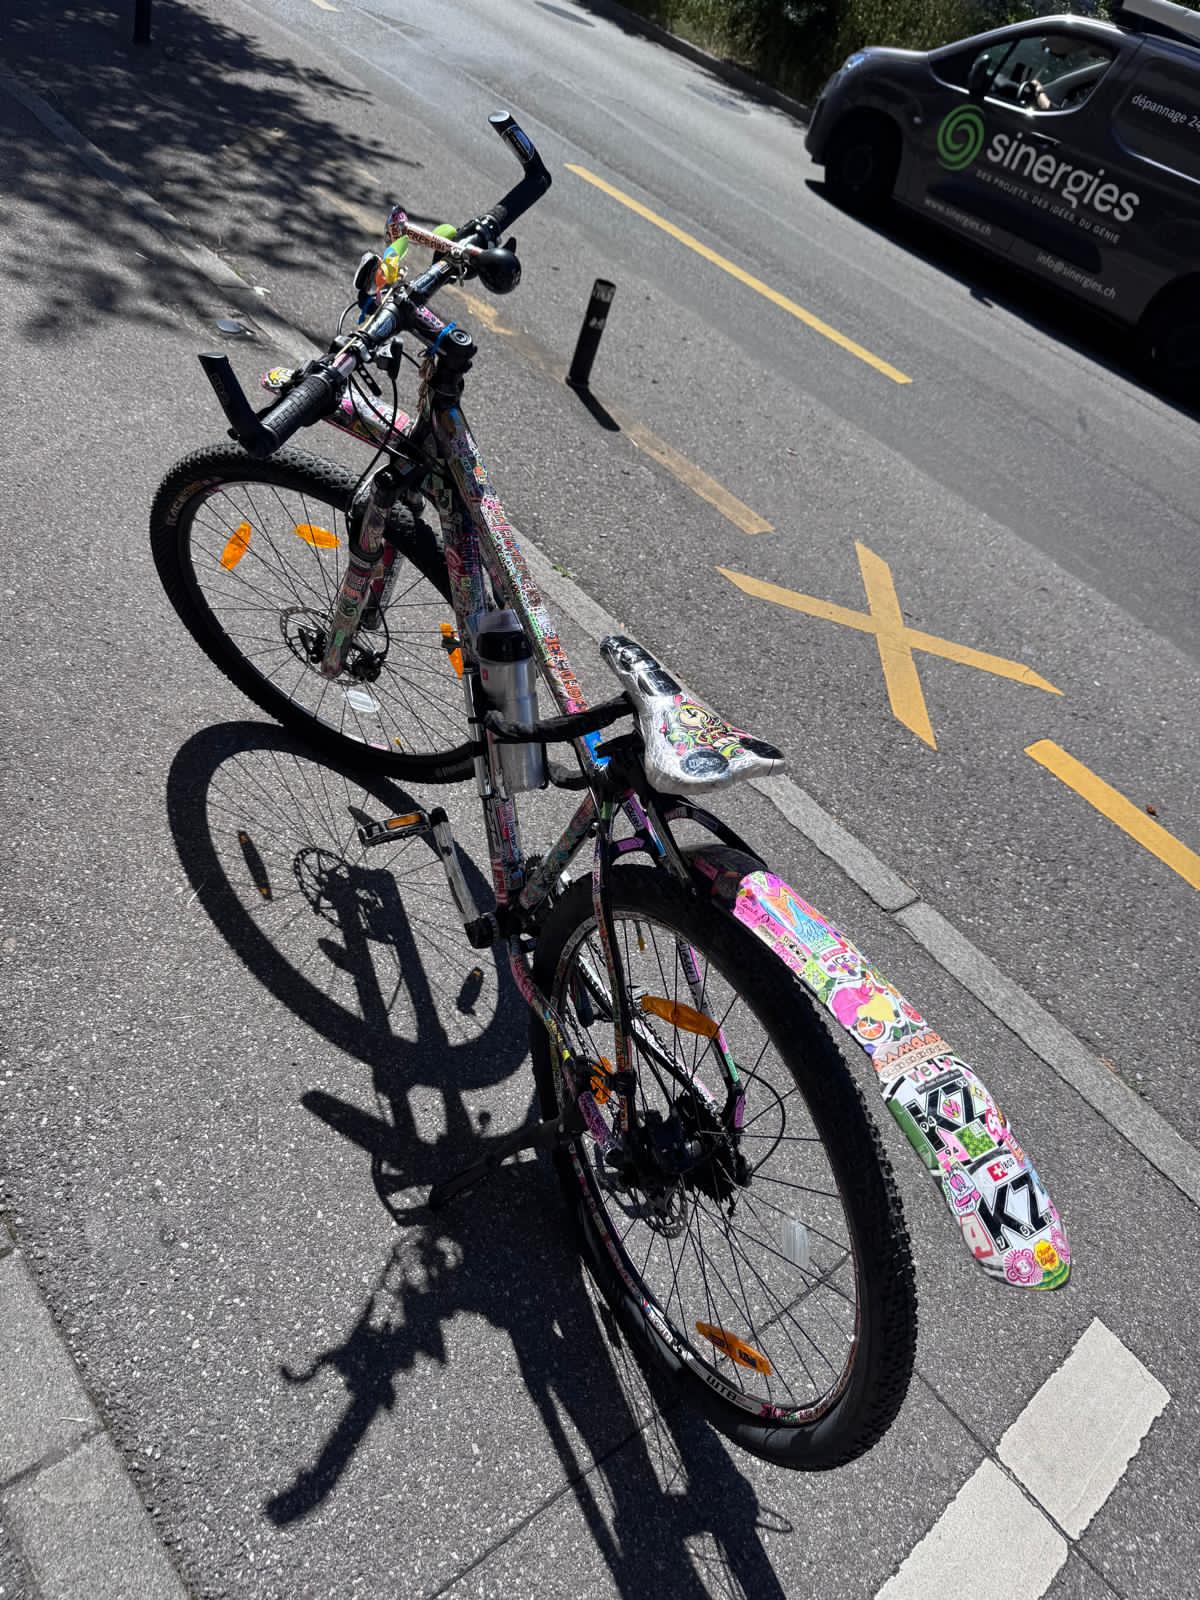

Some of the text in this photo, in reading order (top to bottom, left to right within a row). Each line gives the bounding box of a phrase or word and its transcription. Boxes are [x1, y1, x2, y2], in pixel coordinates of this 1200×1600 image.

[1131, 94, 1187, 123] dépannage
[976, 169, 992, 183] DES
[1031, 194, 1048, 210] DES
[1078, 218, 1091, 231] DU
[987, 132, 1140, 222] sinergies
[924, 196, 993, 236] www.sinergies.ch
[1036, 252, 1117, 299] info@sinergies.ch
